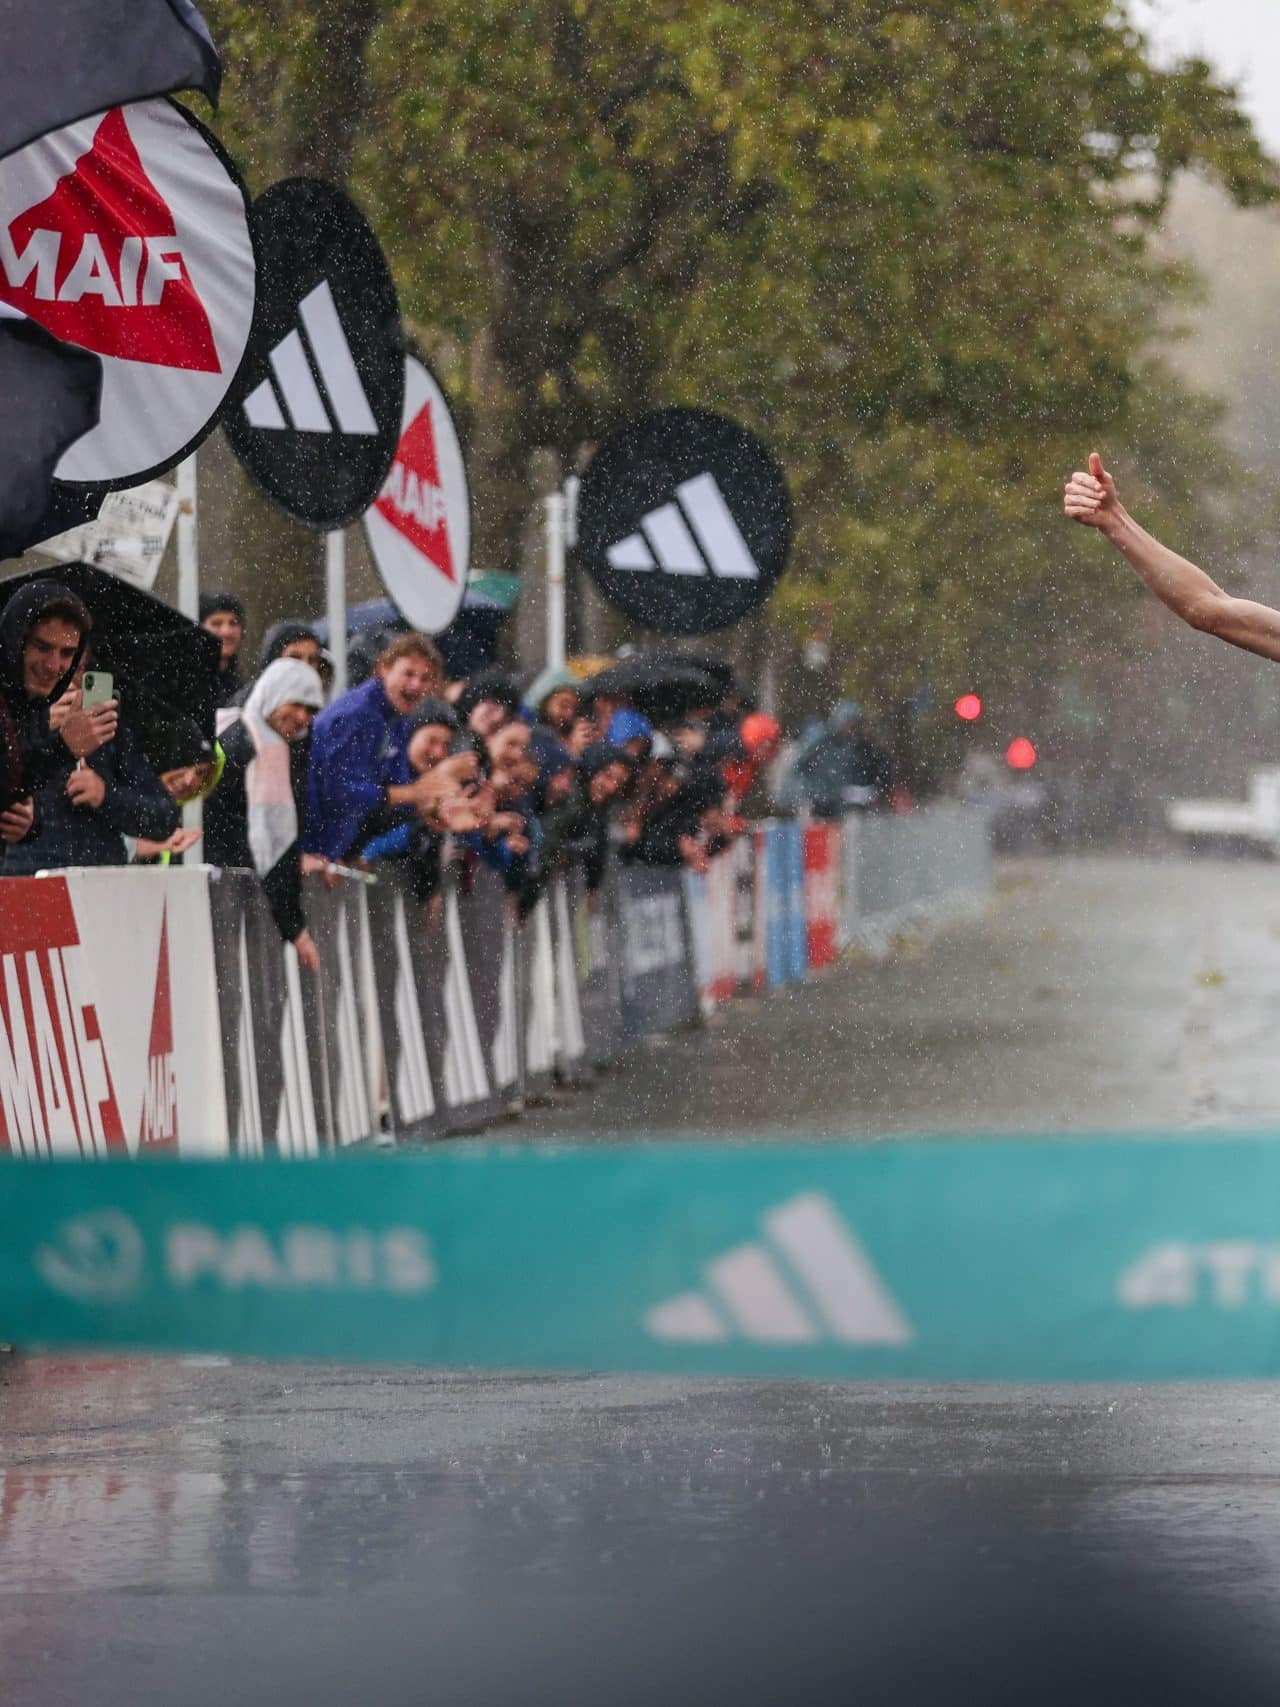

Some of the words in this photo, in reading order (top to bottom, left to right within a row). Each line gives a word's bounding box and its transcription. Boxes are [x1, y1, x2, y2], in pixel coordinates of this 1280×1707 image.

[0, 228, 184, 307] MAIF
[379, 460, 446, 533] MAIF
[163, 1221, 440, 1295] PARIS
